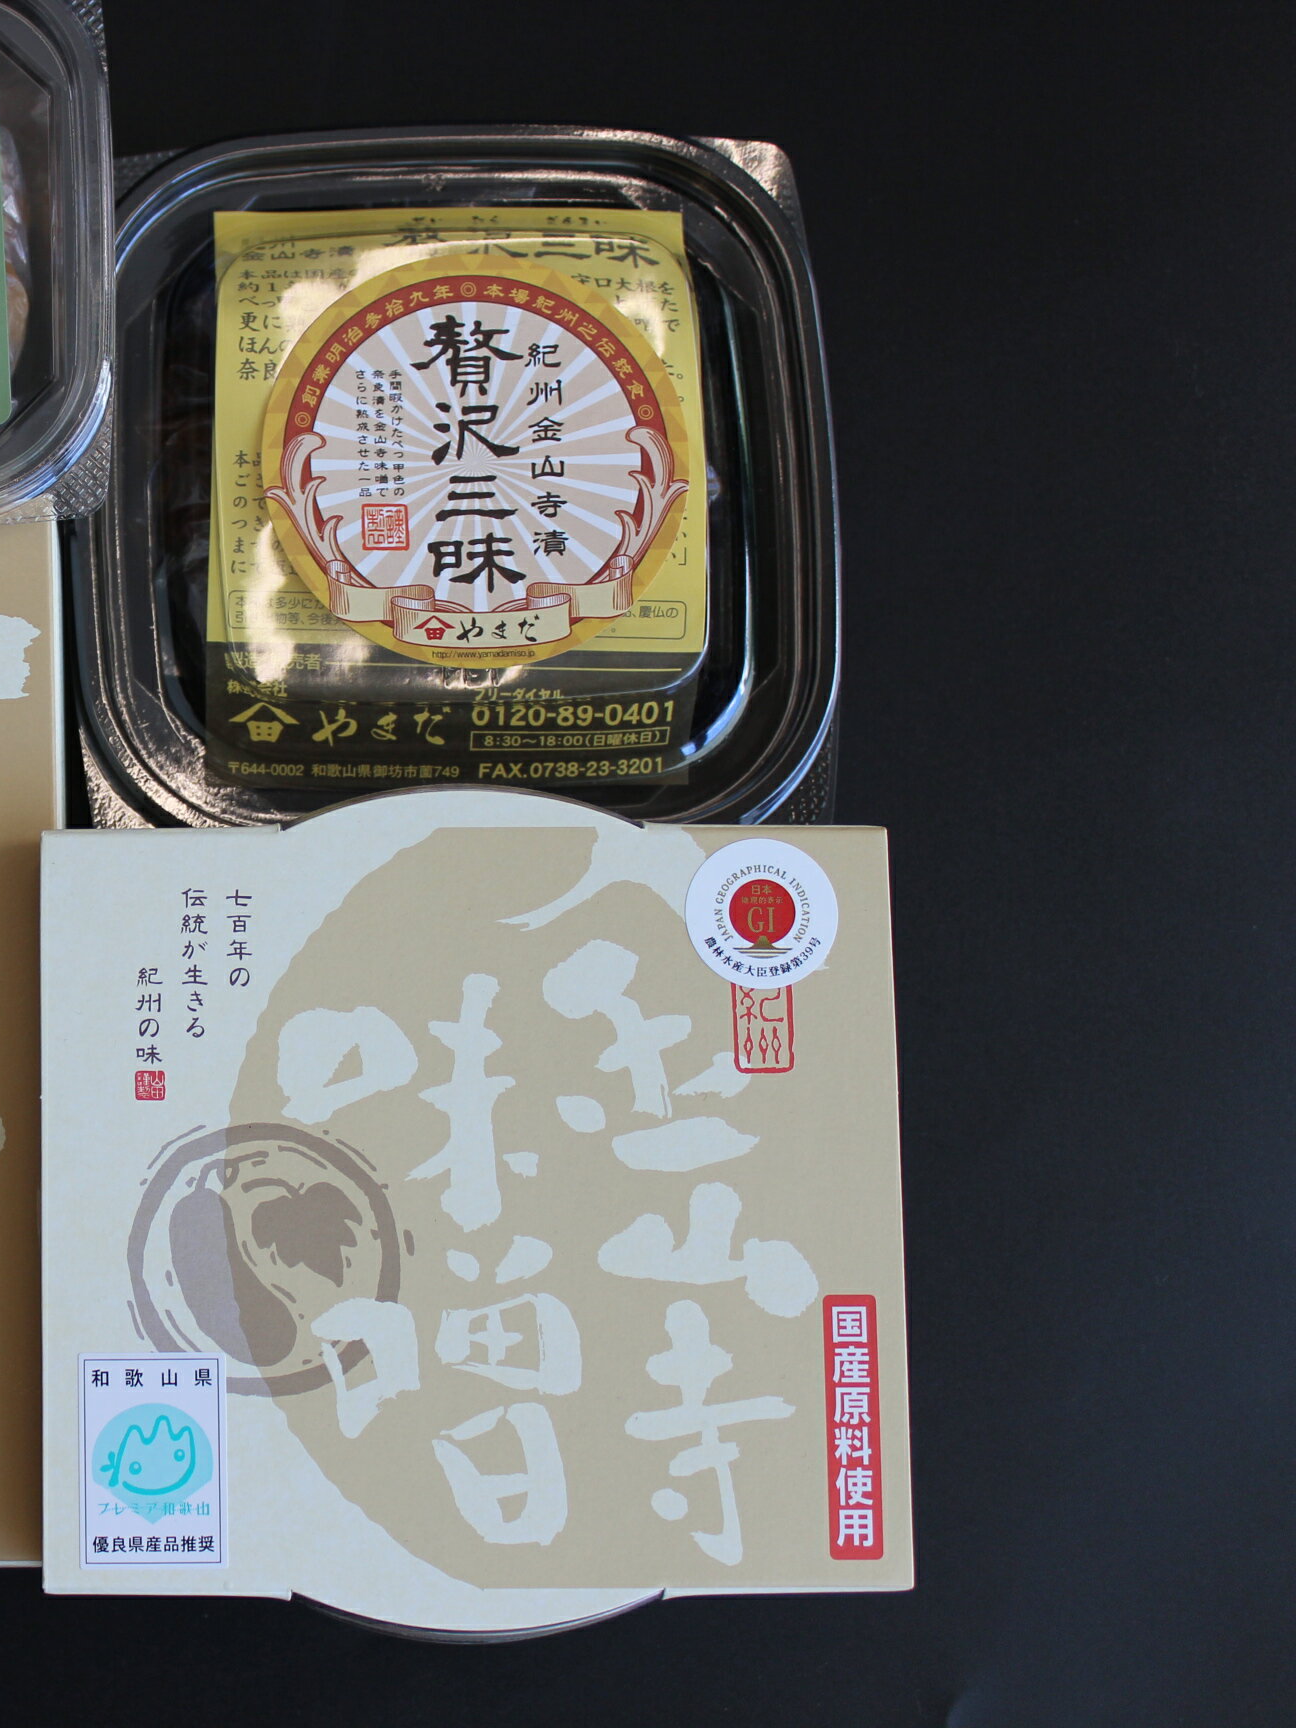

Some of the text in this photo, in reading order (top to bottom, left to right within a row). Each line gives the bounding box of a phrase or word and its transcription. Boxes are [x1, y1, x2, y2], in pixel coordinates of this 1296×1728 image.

[524, 343, 569, 556] 紀州金山寺漬
[456, 614, 540, 643] やまだ
[432, 649, 535, 660] http://www.yamadamiso.jp
[311, 705, 451, 747] やまだ
[471, 700, 675, 727] 0120-89-0401
[712, 864, 811, 944] JAPAN GEOGRAPHICAL INDICATION
[751, 884, 773, 895] 日本
[225, 888, 253, 988] 七百年の
[747, 906, 776, 933] GI
[180, 887, 208, 1039] 伝統が生きる
[704, 936, 822, 978] 農林水産大臣登録第39号
[135, 967, 163, 1065] 紀州の味
[91, 1368, 213, 1388] 和歌山県
[831, 1305, 874, 1548] 国産原料使用
[92, 1536, 215, 1553] 優良県産品推奨
